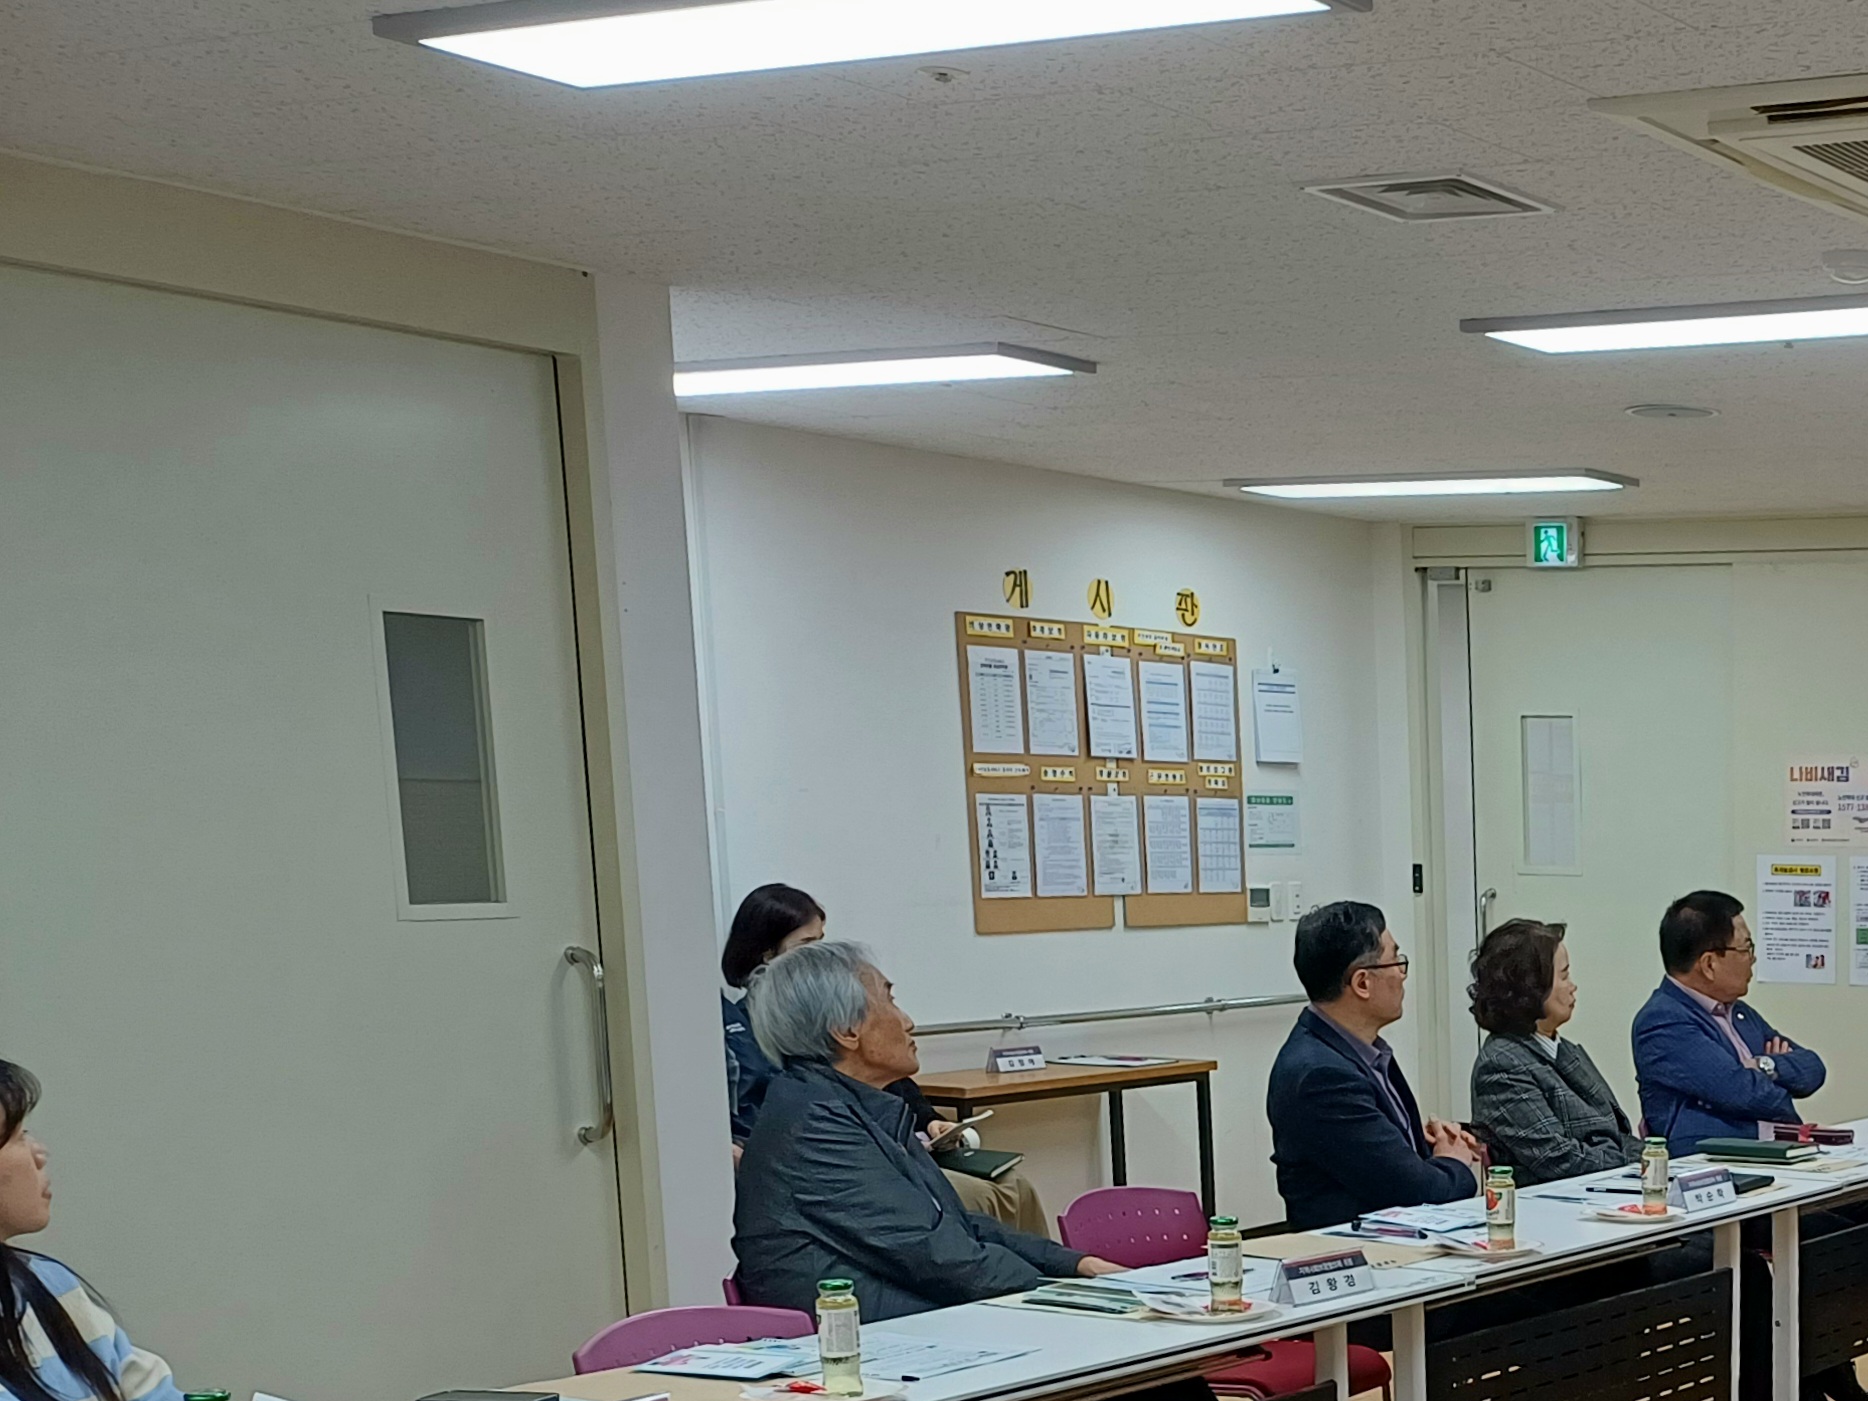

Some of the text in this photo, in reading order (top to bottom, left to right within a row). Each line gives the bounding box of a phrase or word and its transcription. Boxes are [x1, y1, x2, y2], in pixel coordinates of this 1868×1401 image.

[1005, 570, 1198, 627] 게 시 판
[1789, 765, 1850, 783] 나비새김
